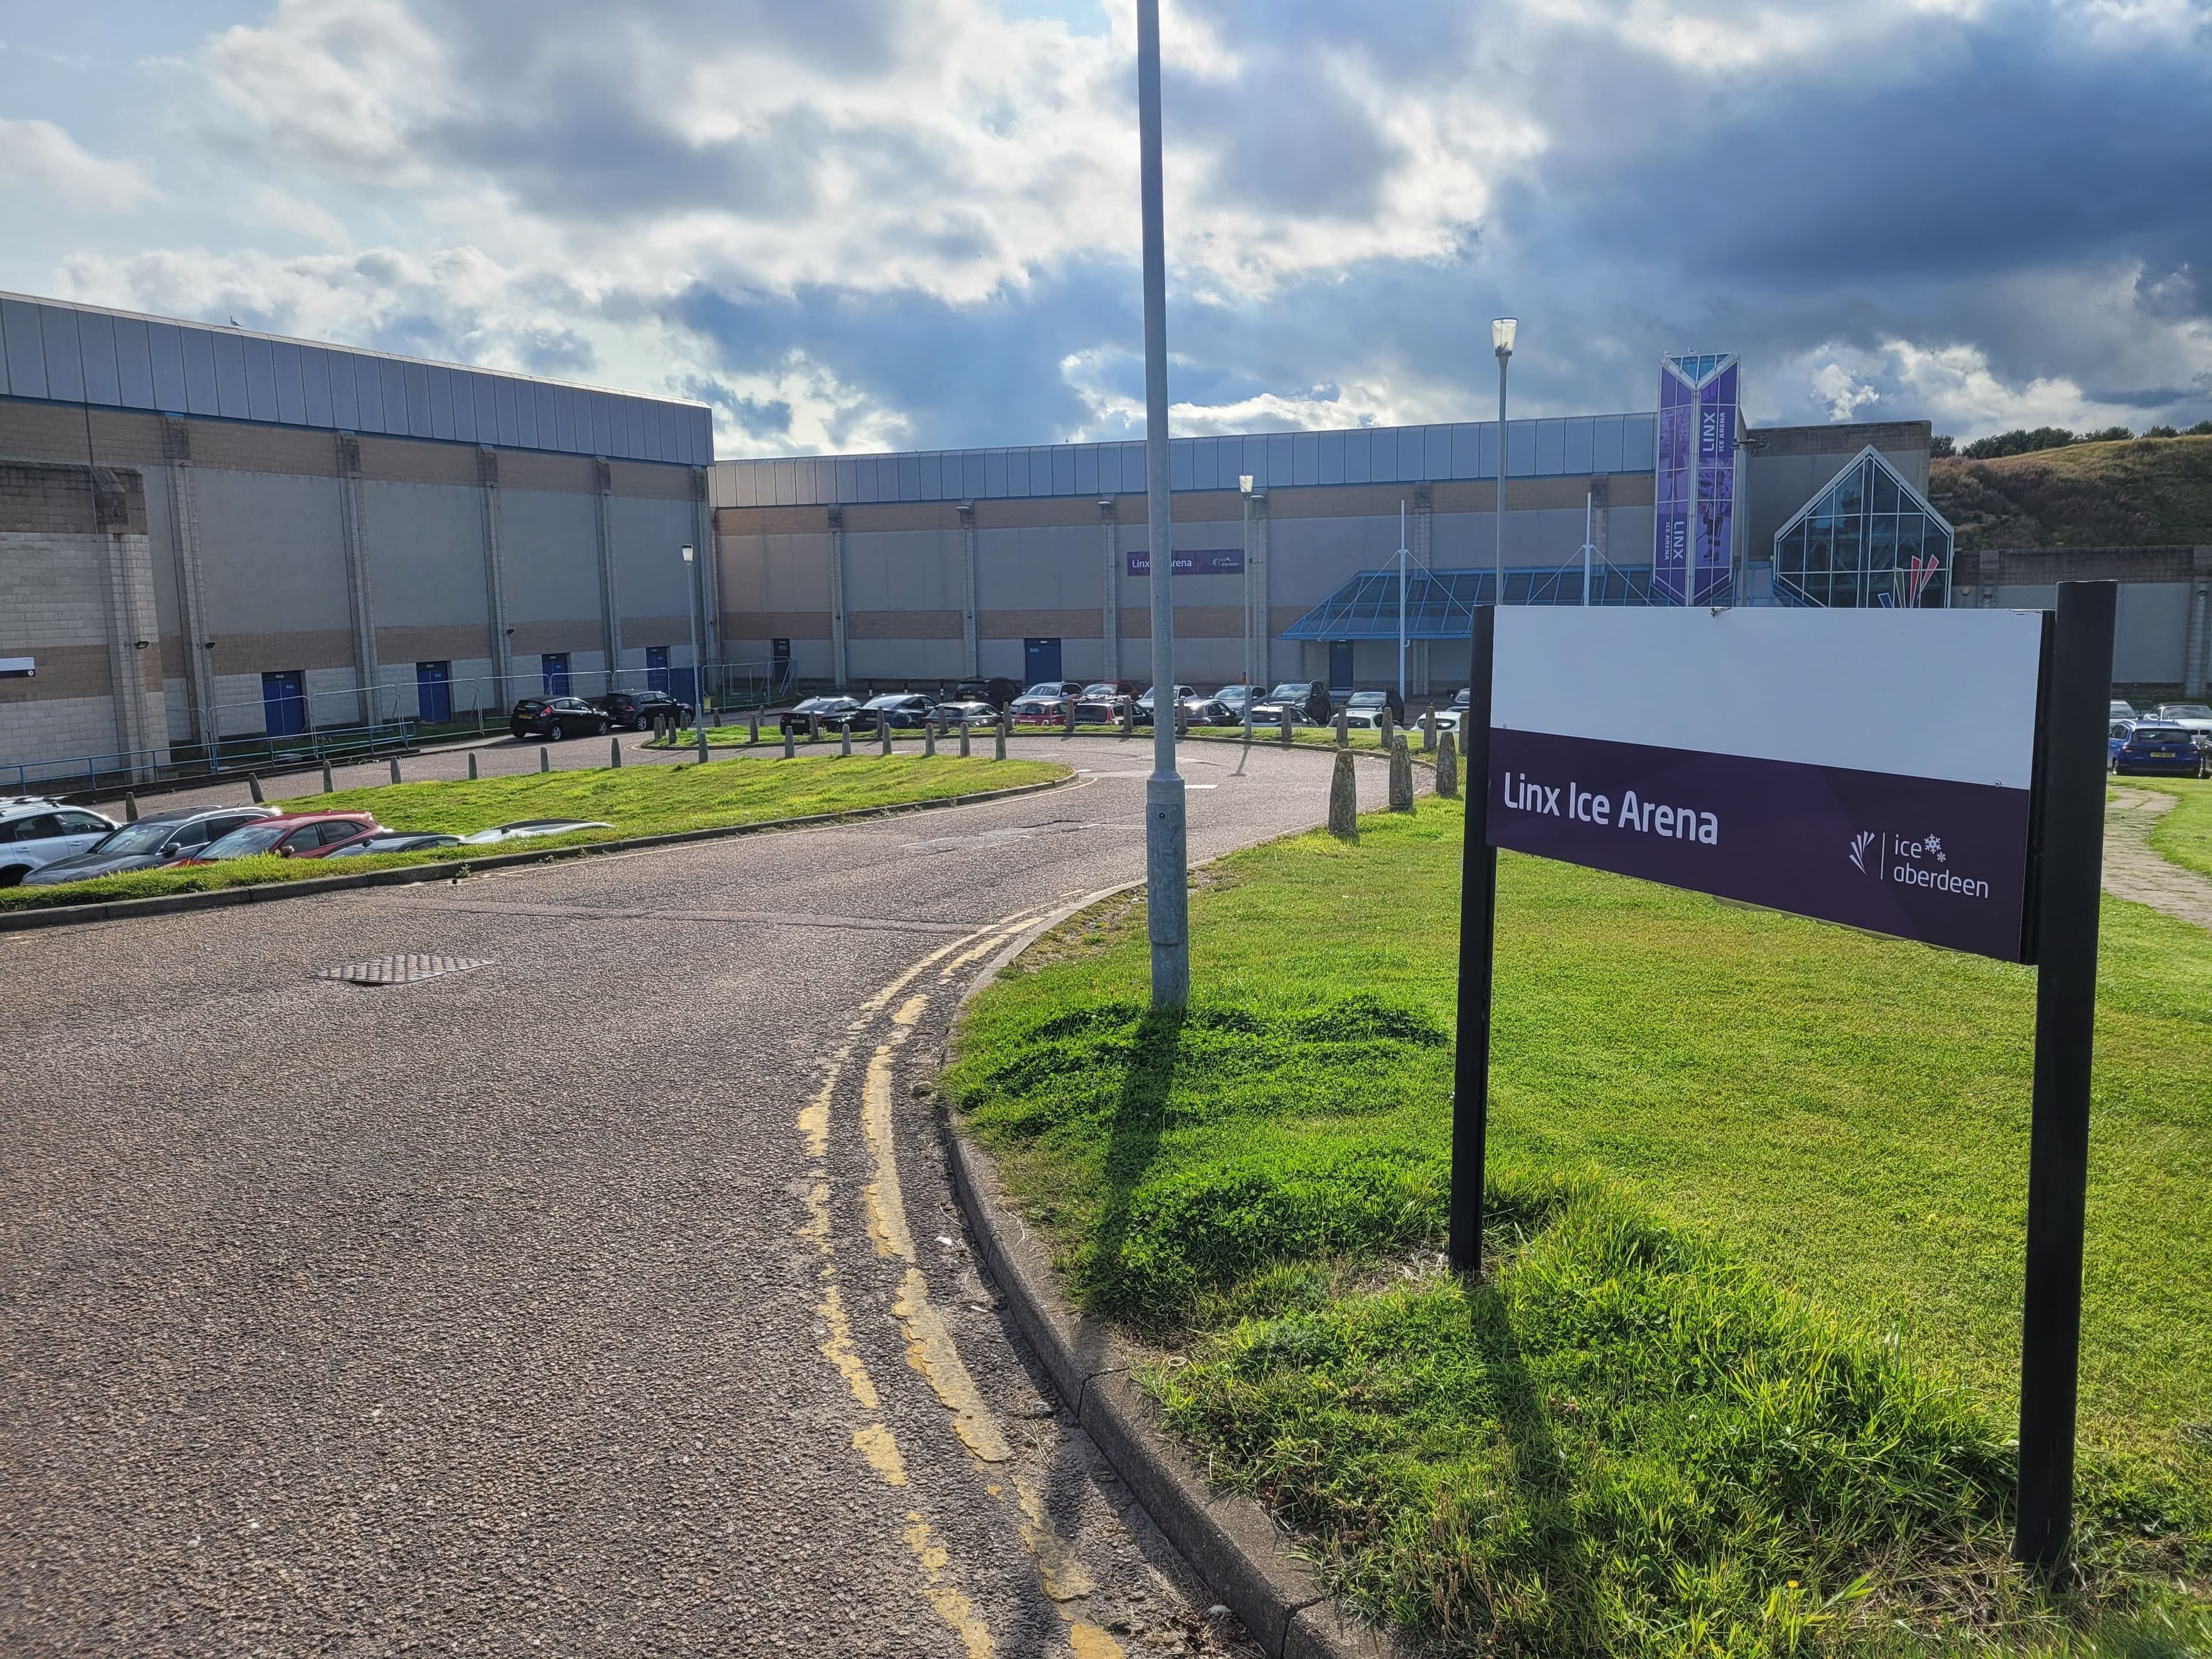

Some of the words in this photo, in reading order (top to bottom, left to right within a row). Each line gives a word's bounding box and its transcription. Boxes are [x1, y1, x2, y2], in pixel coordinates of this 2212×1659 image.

[1702, 412, 1715, 452] LINX
[1673, 521, 1684, 560] LINX
[1132, 559, 1150, 568] Linx
[1504, 772, 1561, 816] Linx
[1569, 782, 1610, 825] Ice
[1618, 790, 1718, 846] Arena
[1895, 834, 1922, 858] ice
[1893, 862, 1989, 899] aberdeen
